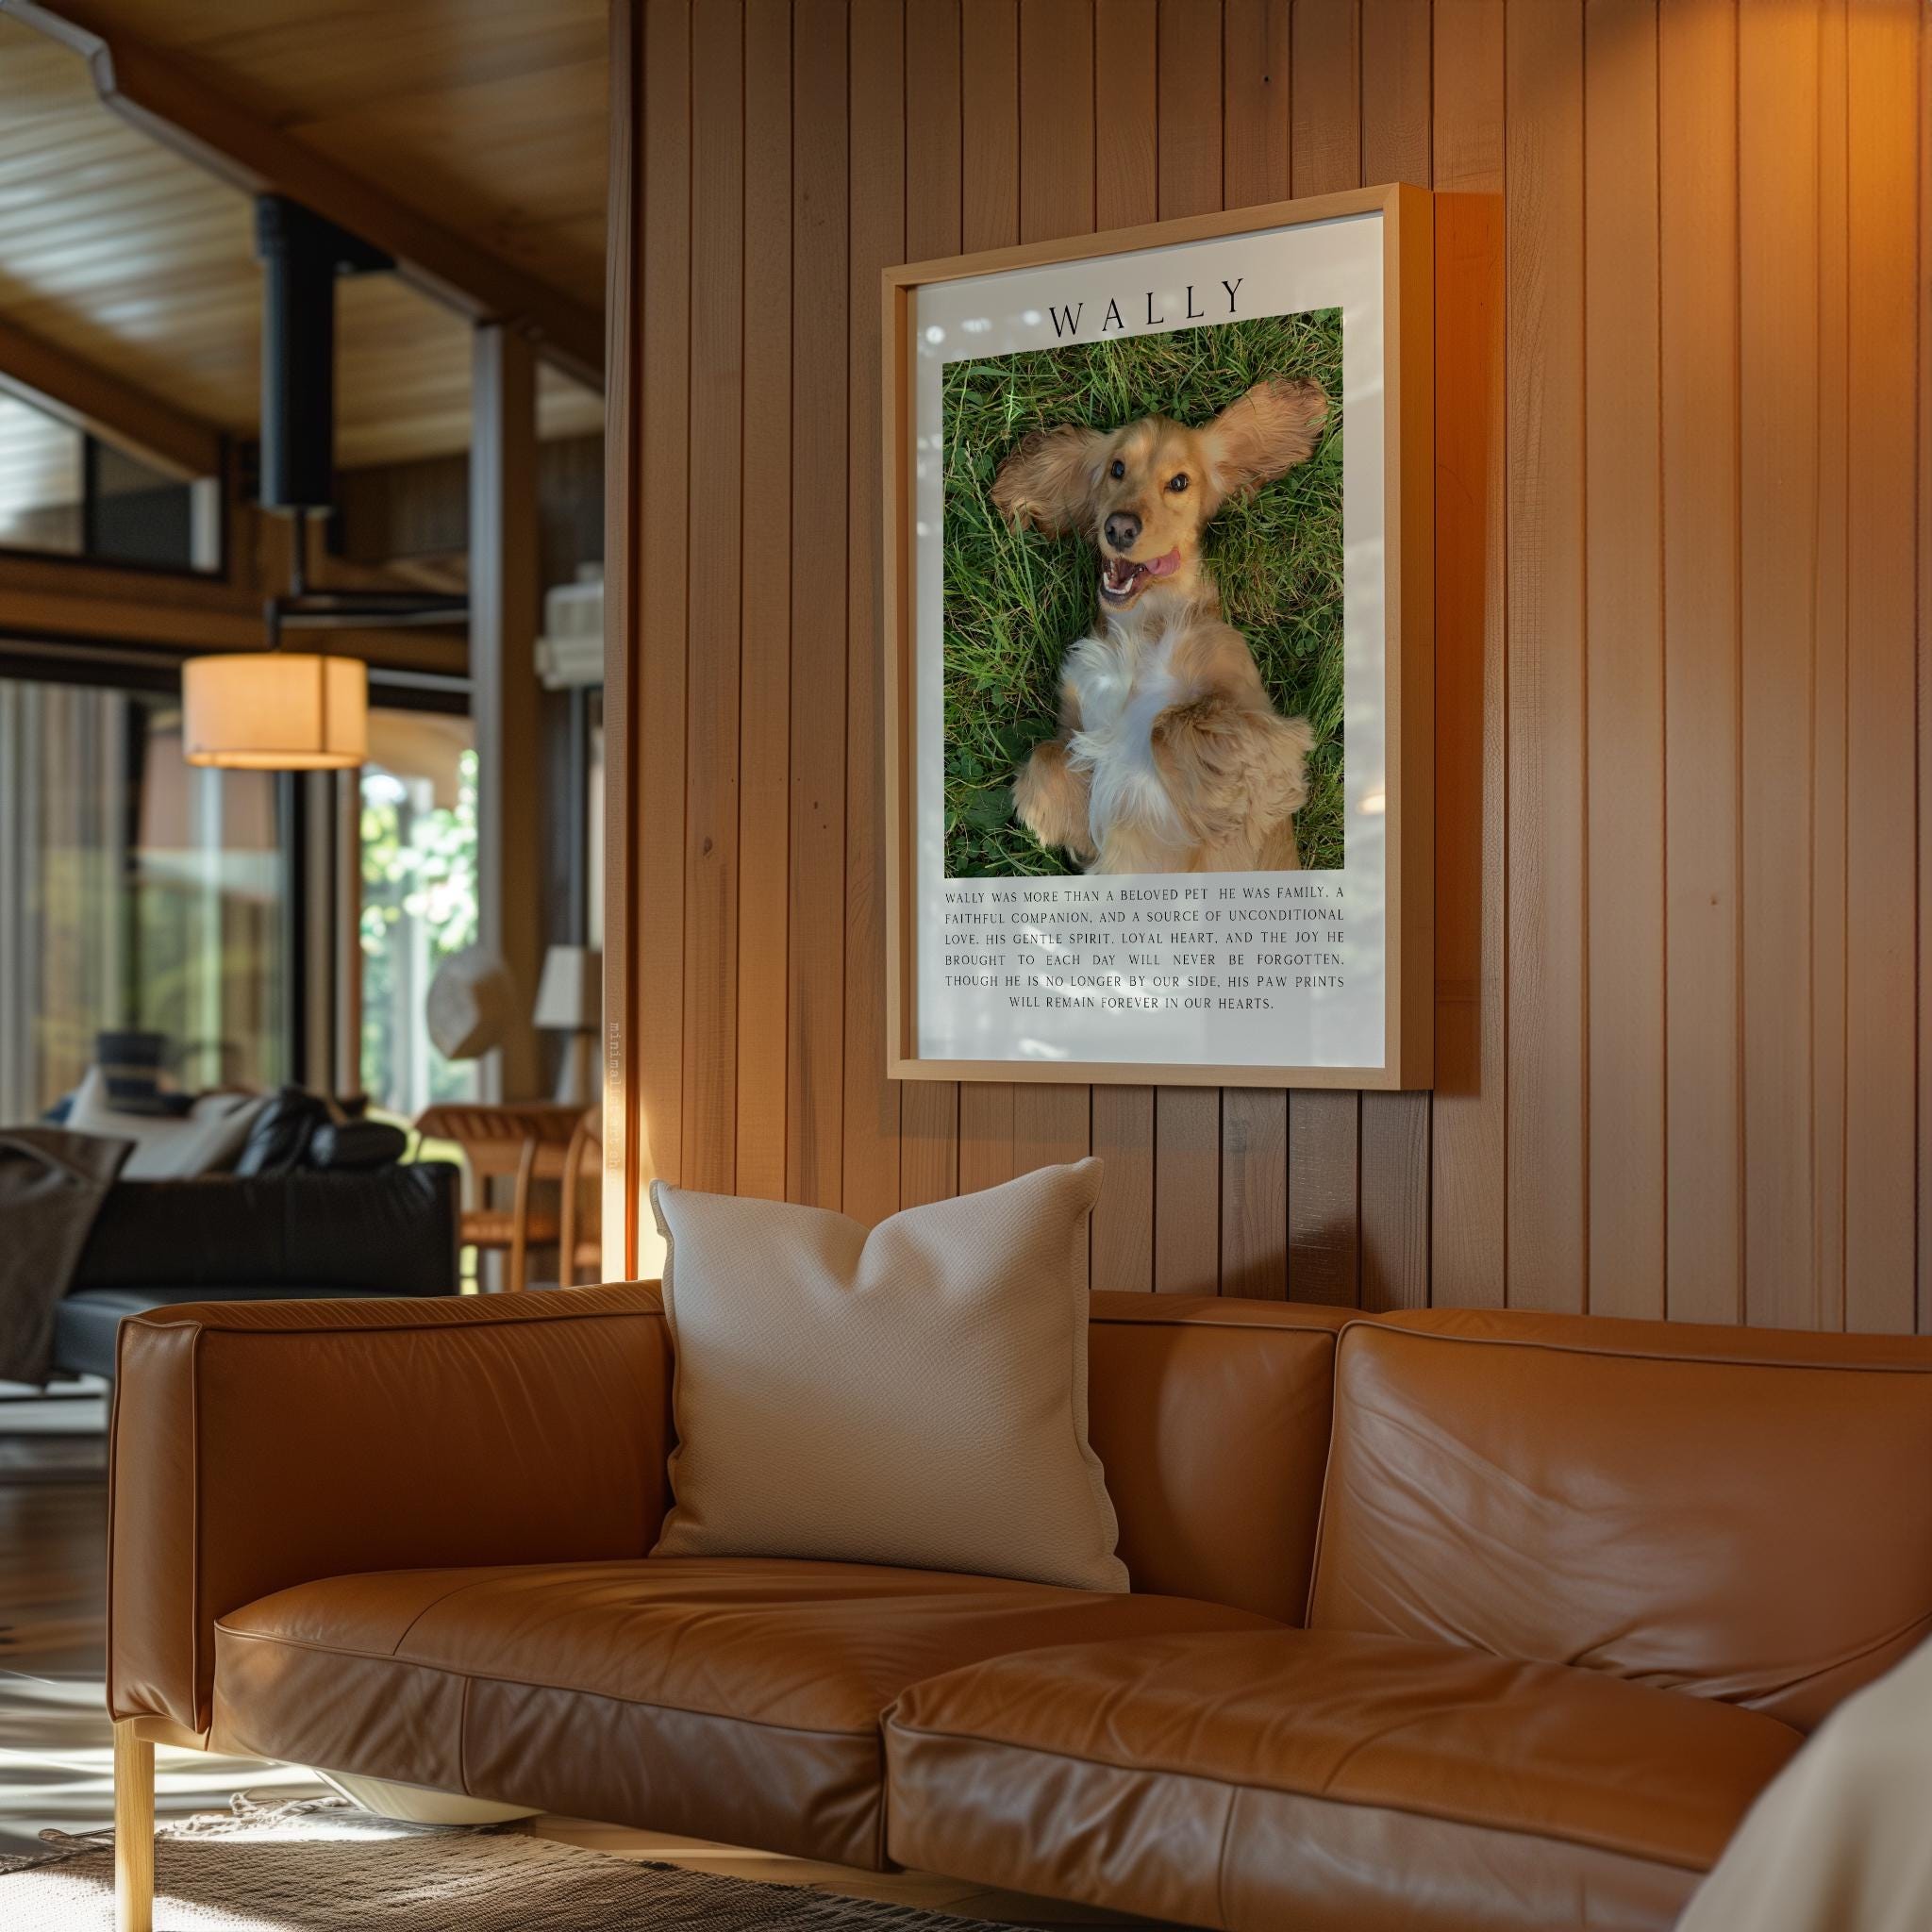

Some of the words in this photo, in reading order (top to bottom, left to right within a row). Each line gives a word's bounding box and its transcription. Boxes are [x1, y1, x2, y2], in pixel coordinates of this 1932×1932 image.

[1048, 277, 1244, 339] WALLY
[945, 891, 985, 904] WALLY
[991, 891, 1018, 903] WAS
[1023, 891, 1058, 903] MORE
[1064, 891, 1100, 902] THAN
[1106, 891, 1114, 902] A
[1120, 889, 1178, 901] BELOVED
[1219, 888, 1236, 899] HE
[1242, 887, 1271, 899] WAS
[1336, 887, 1344, 898] A
[944, 913, 1005, 924] FAITHFUL
[1099, 911, 1125, 923] AND
[1132, 911, 1140, 923] A
[1146, 910, 1199, 923] SOURCE
[1205, 910, 1222, 922] OF
[1229, 908, 1344, 922] UNCONDITIONAL
[986, 934, 1006, 945] HIS
[1013, 933, 1062, 944] GENTLE
[1122, 932, 1162, 944] LOYAL
[1226, 932, 1253, 943] AND
[1260, 931, 1287, 943] THE
[1295, 931, 1319, 943] JOY
[1327, 931, 1344, 943] HE
[945, 955, 1007, 966] BROUGHT
[1018, 955, 1035, 965] TO
[1046, 955, 1080, 966] EACH
[1093, 954, 1115, 966] DAY
[1128, 954, 1160, 965] WILL
[1174, 954, 1215, 965] NEVER
[1229, 954, 1244, 965] BE
[945, 975, 998, 987] THOUGH
[1005, 975, 1021, 987] HE
[1028, 975, 1039, 987] IS
[1046, 975, 1064, 987] NO
[1071, 975, 1121, 987] LONGER
[1129, 975, 1145, 987] BY
[1153, 975, 1179, 988] OUR
[1228, 975, 1250, 988] HIS
[1257, 975, 1287, 987] PAW
[1295, 975, 1344, 988] PRINTS
[1009, 996, 1040, 1008] WILL
[1046, 996, 1094, 1008] REMAIN
[1101, 997, 1159, 1008] FOREVER
[1165, 997, 1178, 1008] IN
[1184, 997, 1211, 1008] OUR
[1218, 997, 1274, 1009] HEARTS.
